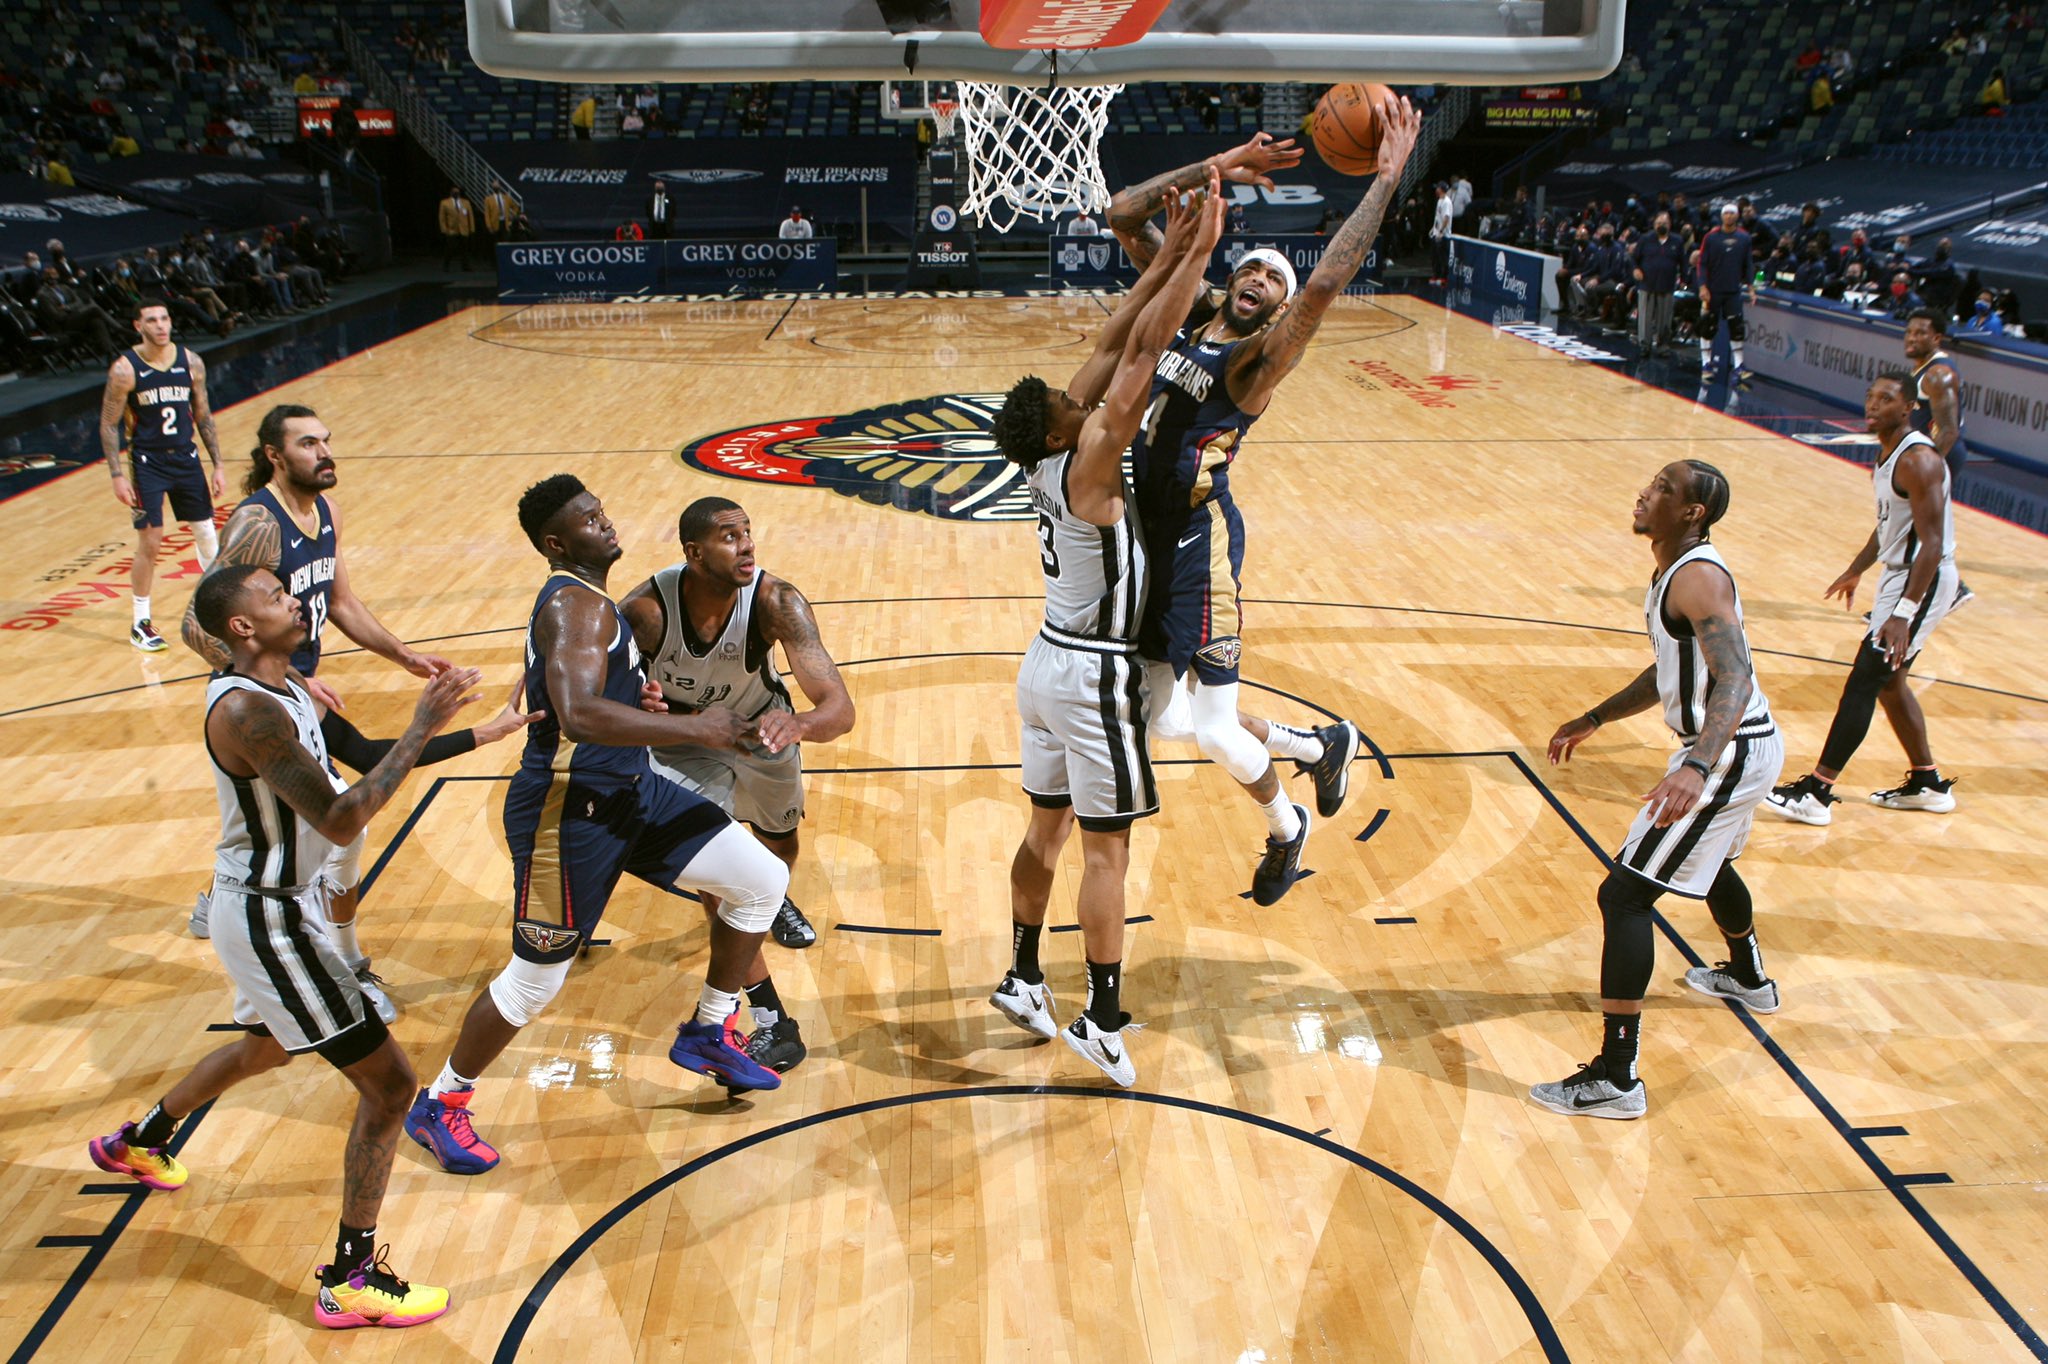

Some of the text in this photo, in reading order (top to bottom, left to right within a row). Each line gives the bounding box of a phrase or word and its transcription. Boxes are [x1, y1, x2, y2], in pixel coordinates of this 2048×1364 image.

[1486, 107, 1505, 118] BIG
[1532, 107, 1551, 118] BIG
[519, 172, 625, 184] PELICANS
[785, 173, 888, 184] PELICANS
[786, 167, 889, 175] NEW ORLEANS
[511, 246, 646, 266] GREY GOOSE
[682, 243, 817, 262] GREY GOOSE
[917, 252, 969, 263] TISSOT
[555, 271, 606, 282] VODKA
[726, 268, 776, 279] VODKA
[612, 294, 746, 303] NEW
[763, 290, 1005, 300] ORLEANS
[1803, 339, 1822, 367] THE
[1822, 345, 1863, 379] OFFICIAL
[1866, 356, 1875, 381] &
[136, 387, 159, 407] NEW
[1983, 387, 2029, 427] UNION
[161, 406, 178, 436] 2
[716, 424, 805, 476] PELICANS
[1037, 511, 1061, 580] 3
[34, 540, 127, 583] CENTER
[290, 562, 312, 597] NEW
[308, 591, 328, 641] 12
[662, 670, 696, 691] 12
